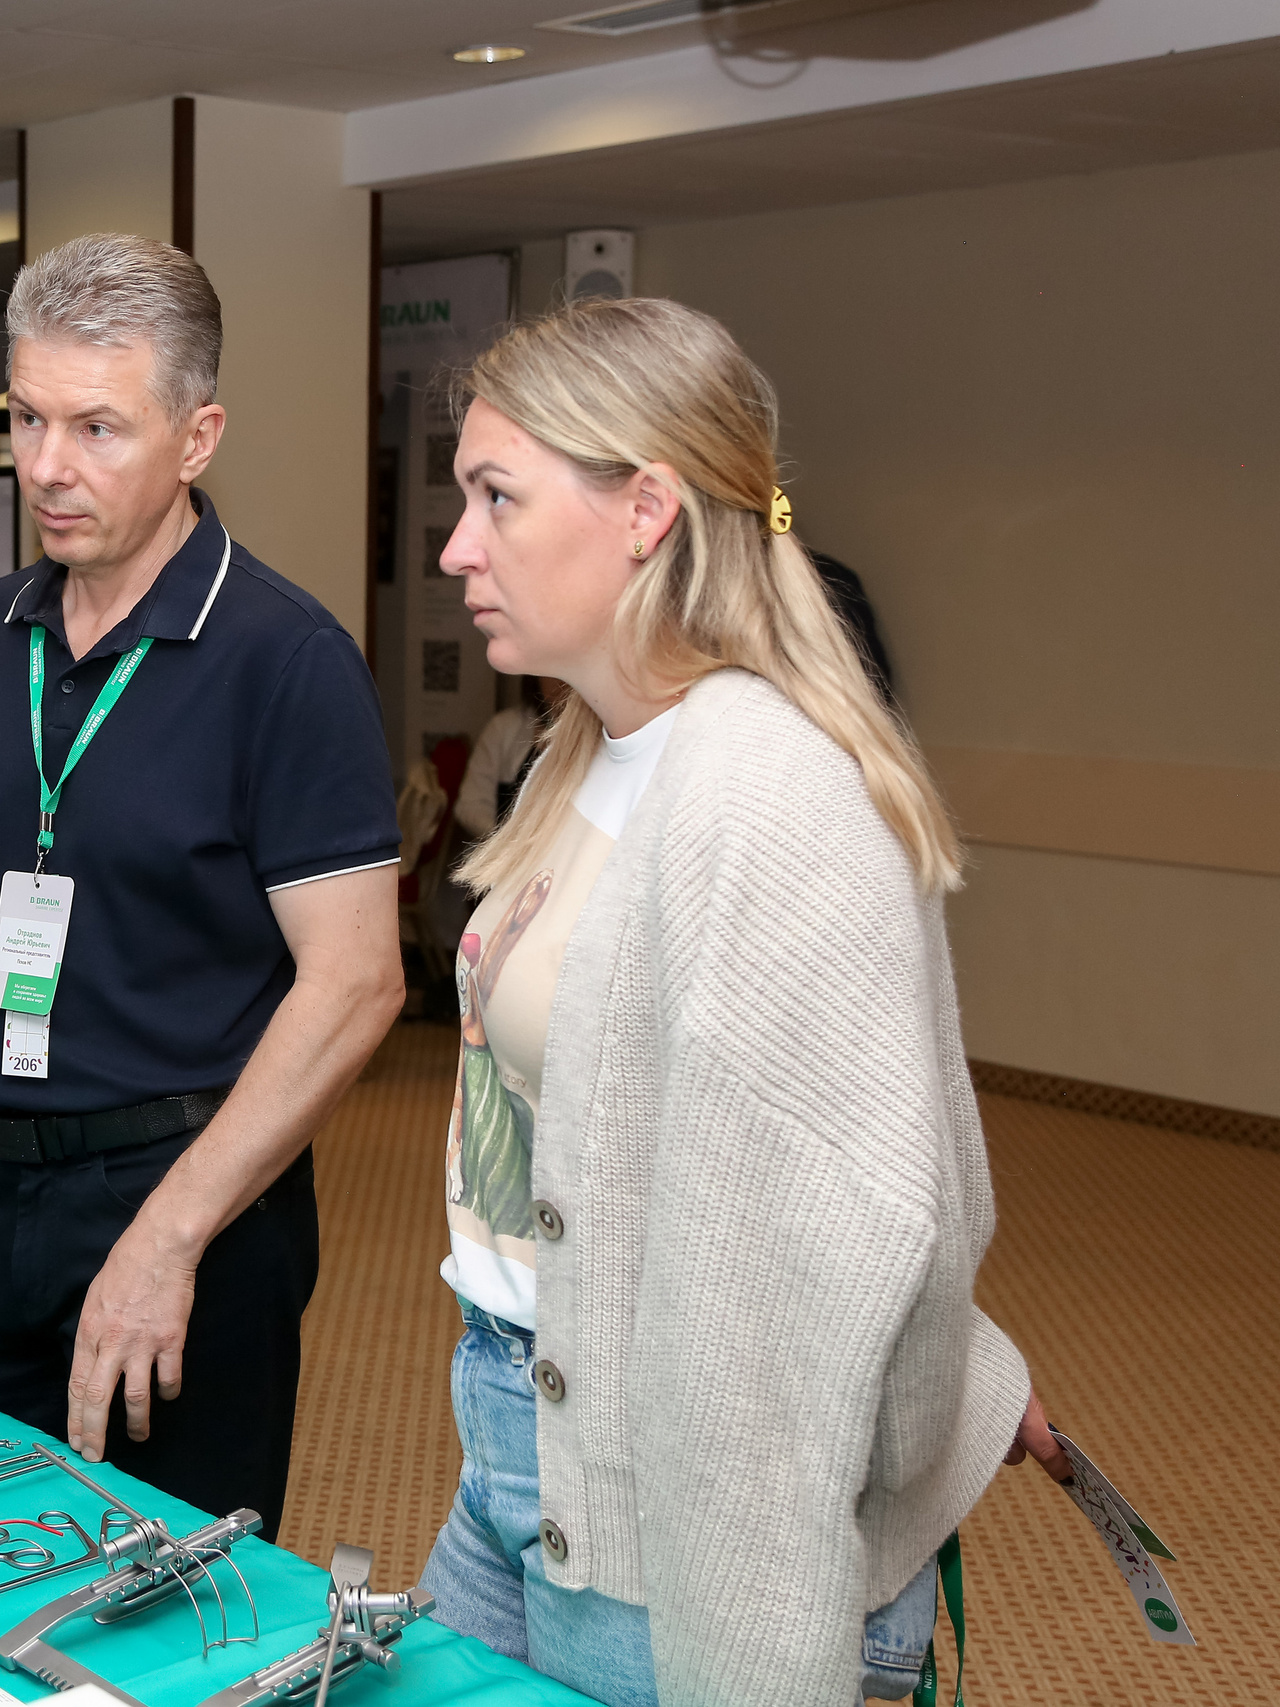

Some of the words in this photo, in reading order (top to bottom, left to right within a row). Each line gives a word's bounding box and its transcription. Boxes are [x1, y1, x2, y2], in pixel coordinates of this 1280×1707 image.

[381, 299, 451, 328] RAUN
[36, 897, 60, 906] BRAUN
[6, 936, 26, 946] Андрей
[27, 938, 51, 949] Юрьевич
[13, 1056, 38, 1072] 206
